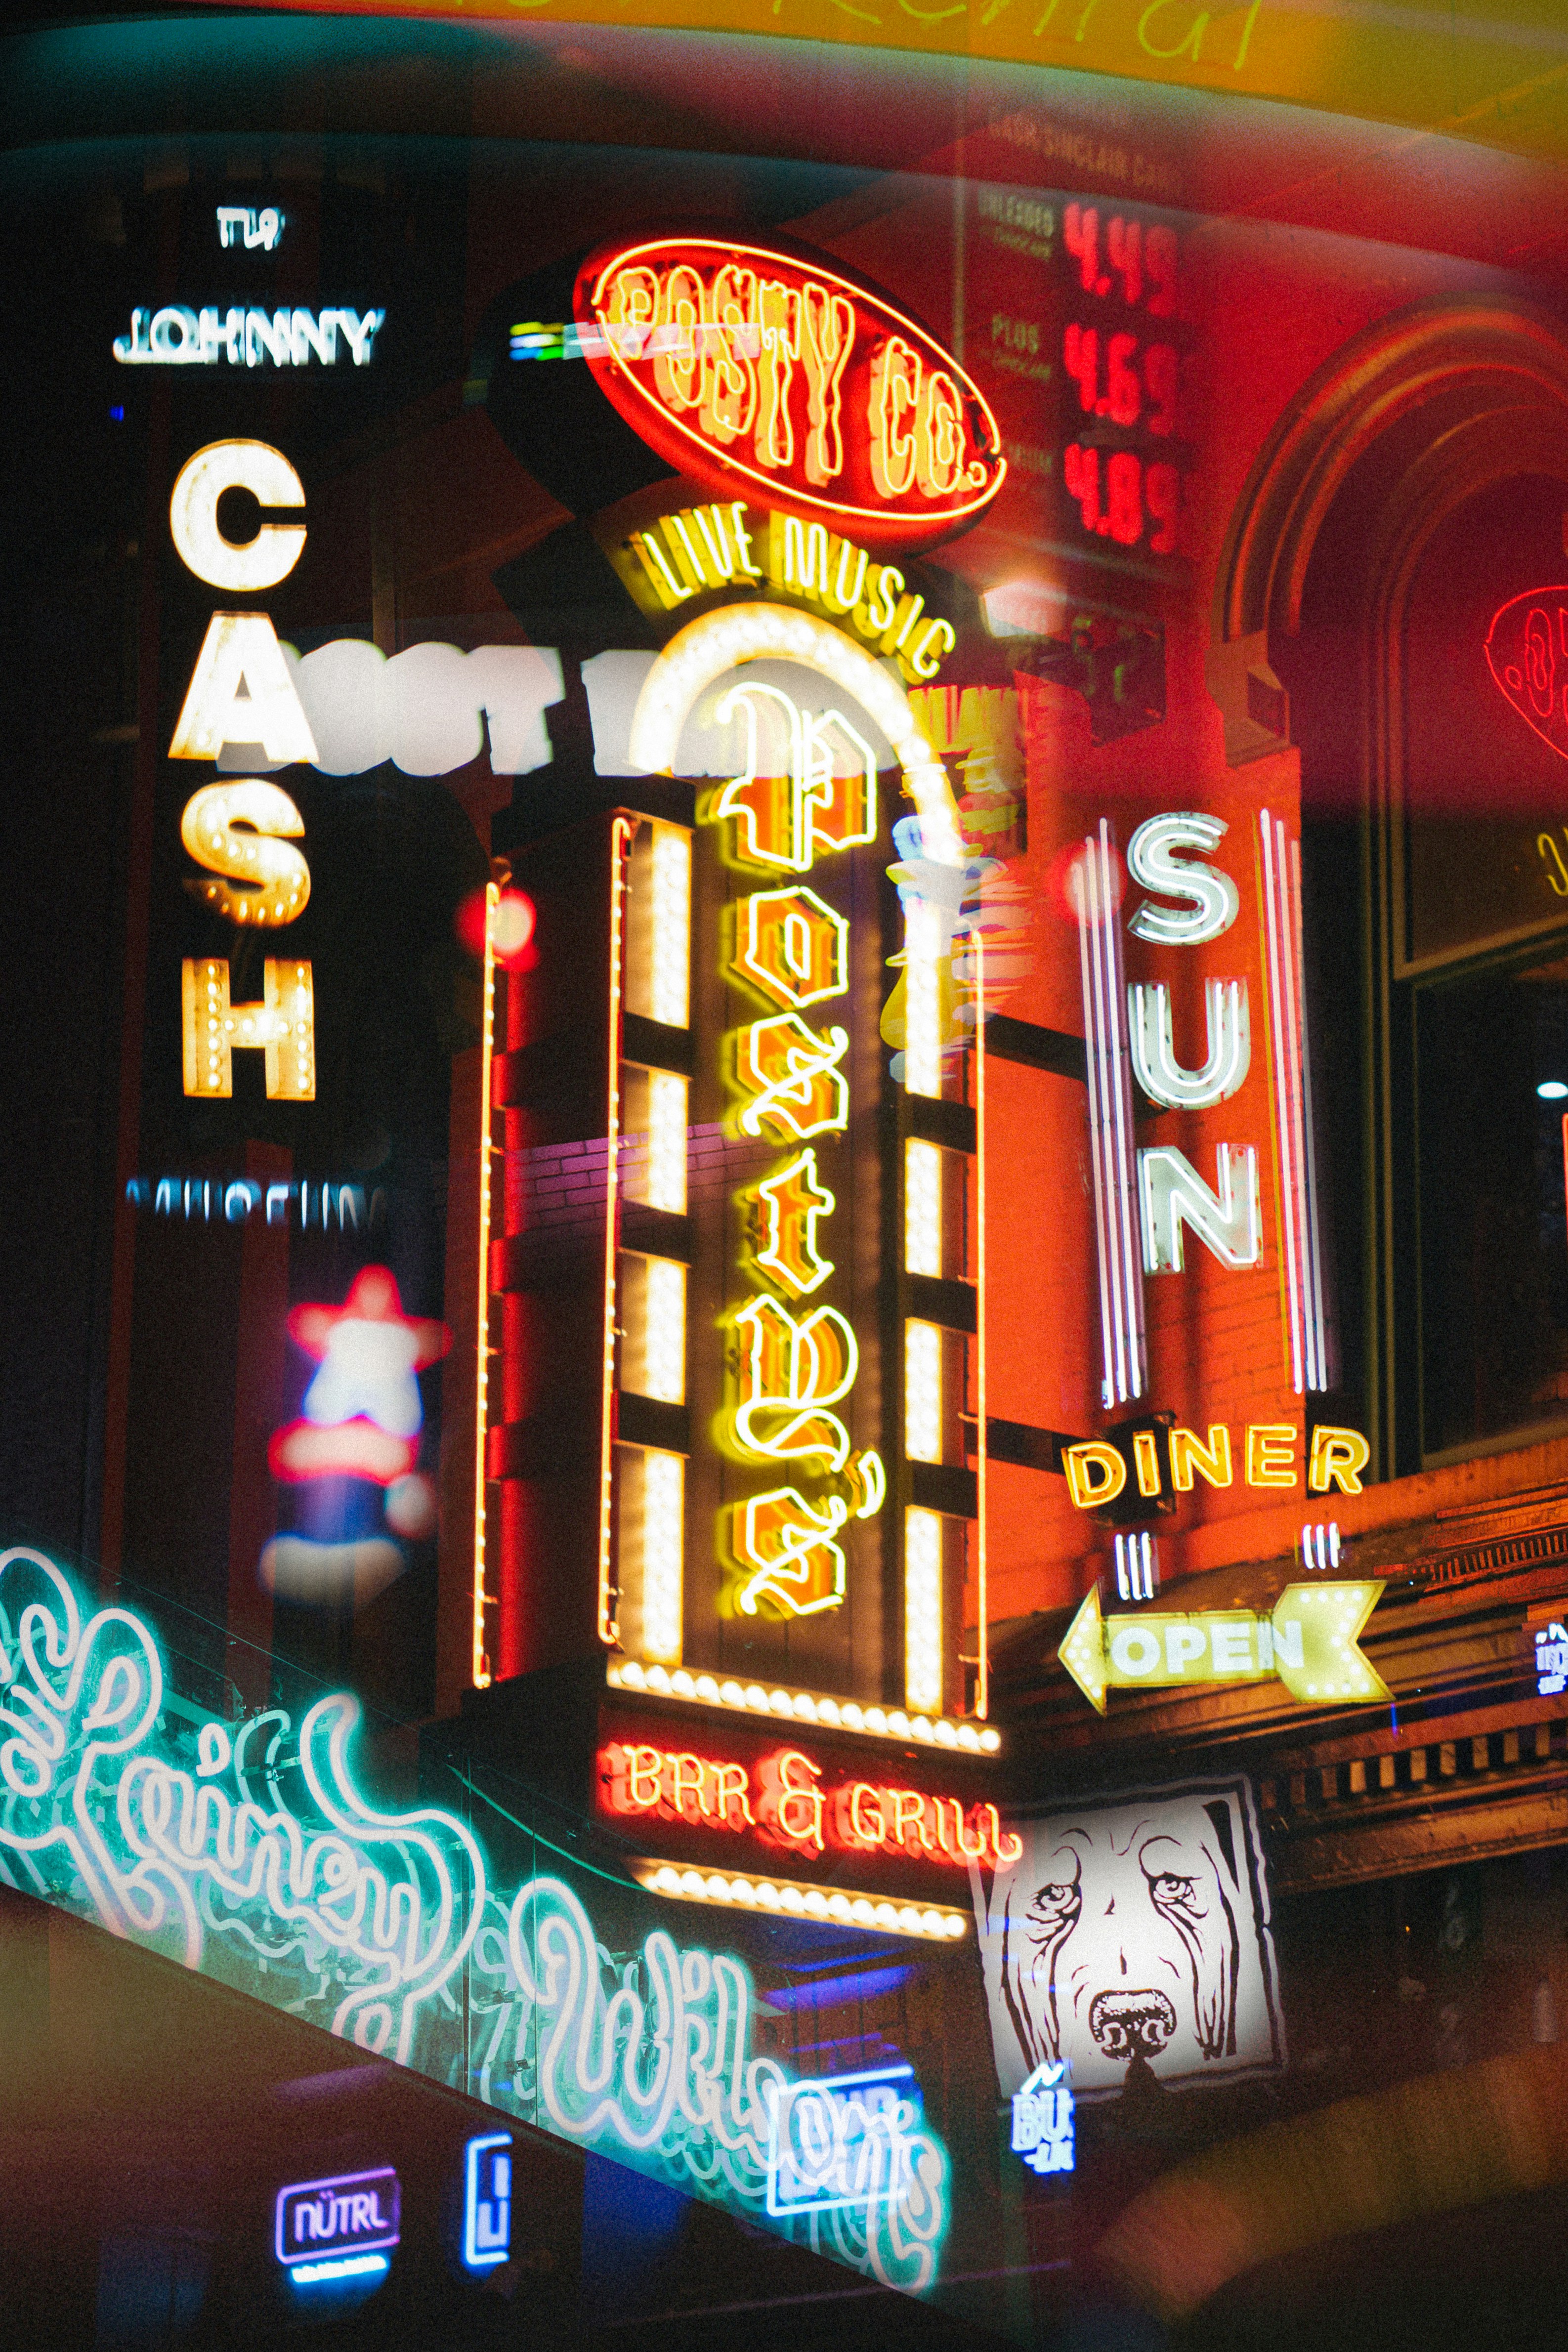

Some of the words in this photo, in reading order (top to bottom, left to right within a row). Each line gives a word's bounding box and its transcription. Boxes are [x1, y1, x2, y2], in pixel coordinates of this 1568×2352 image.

[113, 306, 385, 368] JOHNNY
[612, 263, 856, 480] POSTY
[636, 500, 763, 601] LIVE
[776, 513, 957, 682] MUSIC
[168, 437, 320, 1102] CASH
[1127, 810, 1264, 1275] SUN
[1062, 1422, 1371, 1510] DINER
[1110, 1619, 1305, 1678] OPEN
[614, 1742, 757, 1827] BAR
[772, 1749, 827, 1851] &
[846, 1781, 1024, 1863] GRILL
[1012, 2088, 1074, 2151] BU
